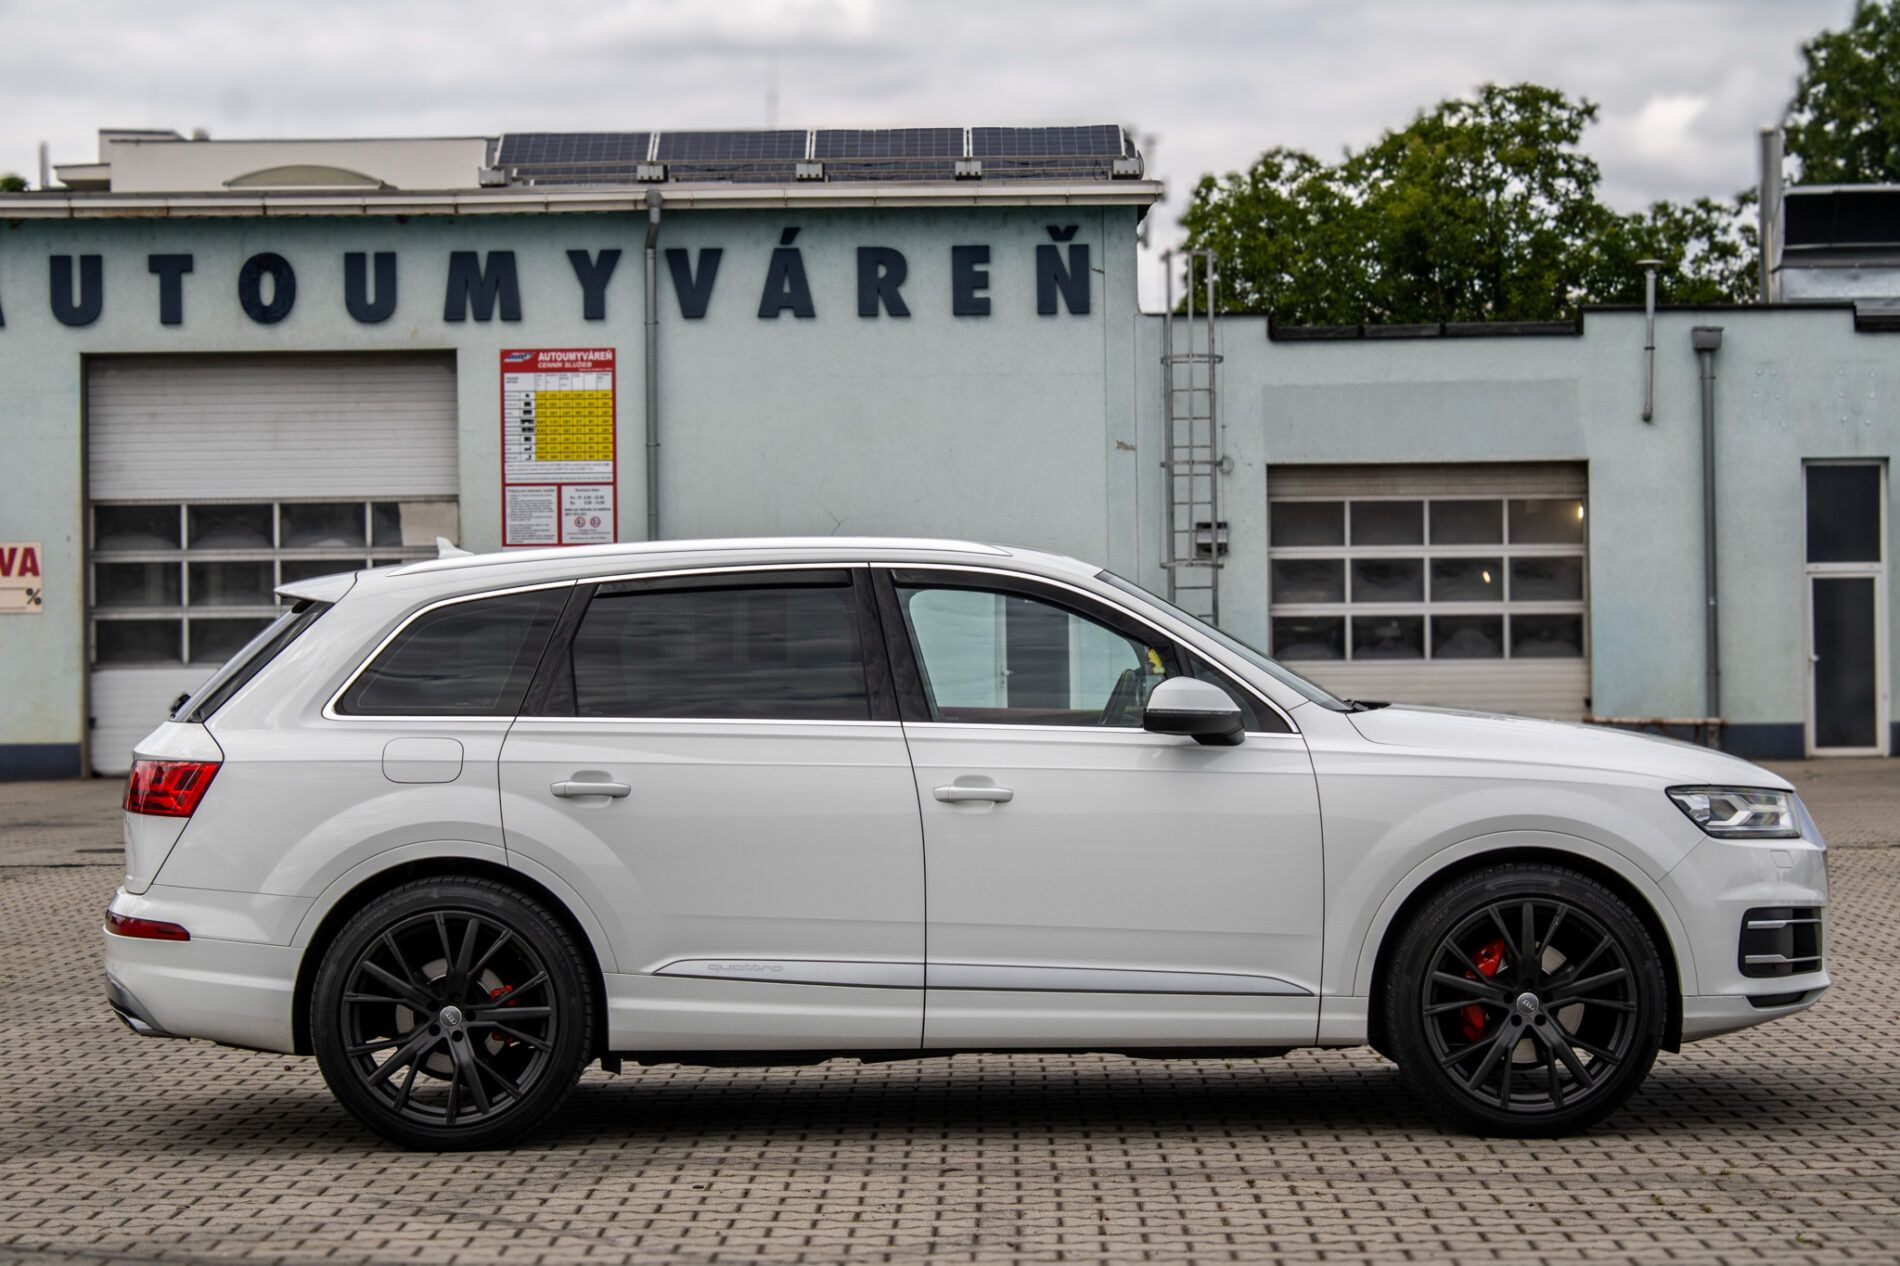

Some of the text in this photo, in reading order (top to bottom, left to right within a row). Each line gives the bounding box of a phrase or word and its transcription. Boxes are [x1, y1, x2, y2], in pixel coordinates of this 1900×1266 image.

[0, 225, 1091, 327] UTOUMYVÁREŇ
[537, 349, 613, 361] AUTOUMYVÁREŇ
[707, 963, 784, 974] quattro
